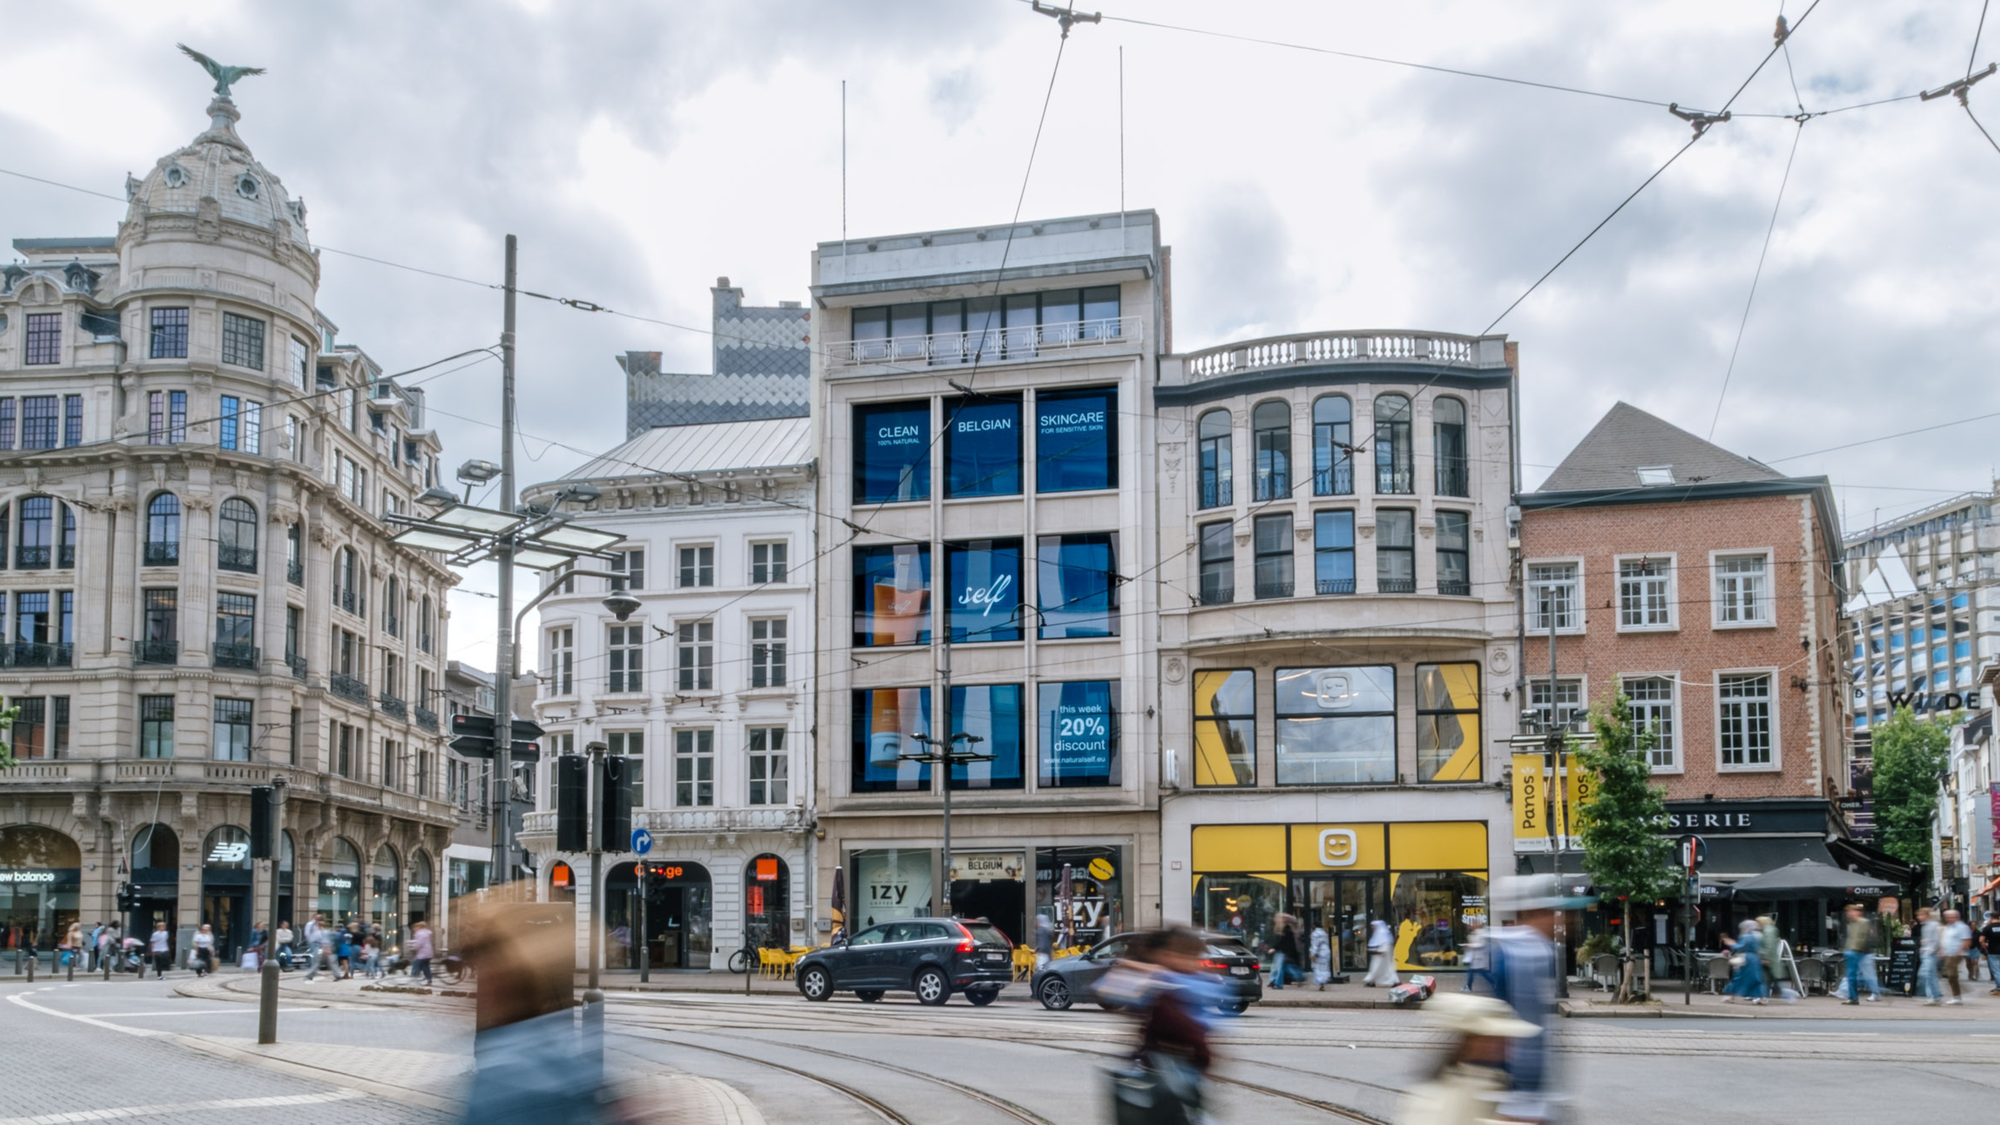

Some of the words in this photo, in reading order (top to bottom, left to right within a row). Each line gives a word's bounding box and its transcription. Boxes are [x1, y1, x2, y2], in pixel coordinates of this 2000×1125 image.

[1040, 411, 1104, 427] SKINCARE
[958, 418, 1011, 433] BELGIAN
[1055, 425, 1087, 433] SENSITIVE
[1088, 424, 1103, 432] SKIN
[878, 426, 919, 439] CLEAN
[893, 437, 920, 445] NATURAL
[958, 574, 1012, 617] self
[1060, 705, 1076, 714] this
[1078, 704, 1102, 713] week
[1060, 717, 1105, 736] 20%
[1054, 740, 1106, 751] discount
[1044, 756, 1106, 764] www.naturalself.eu
[1523, 775, 1535, 829] Panos
[968, 861, 1003, 870] BELGIUM
[0, 873, 13, 882] ew
[14, 871, 55, 882] balance
